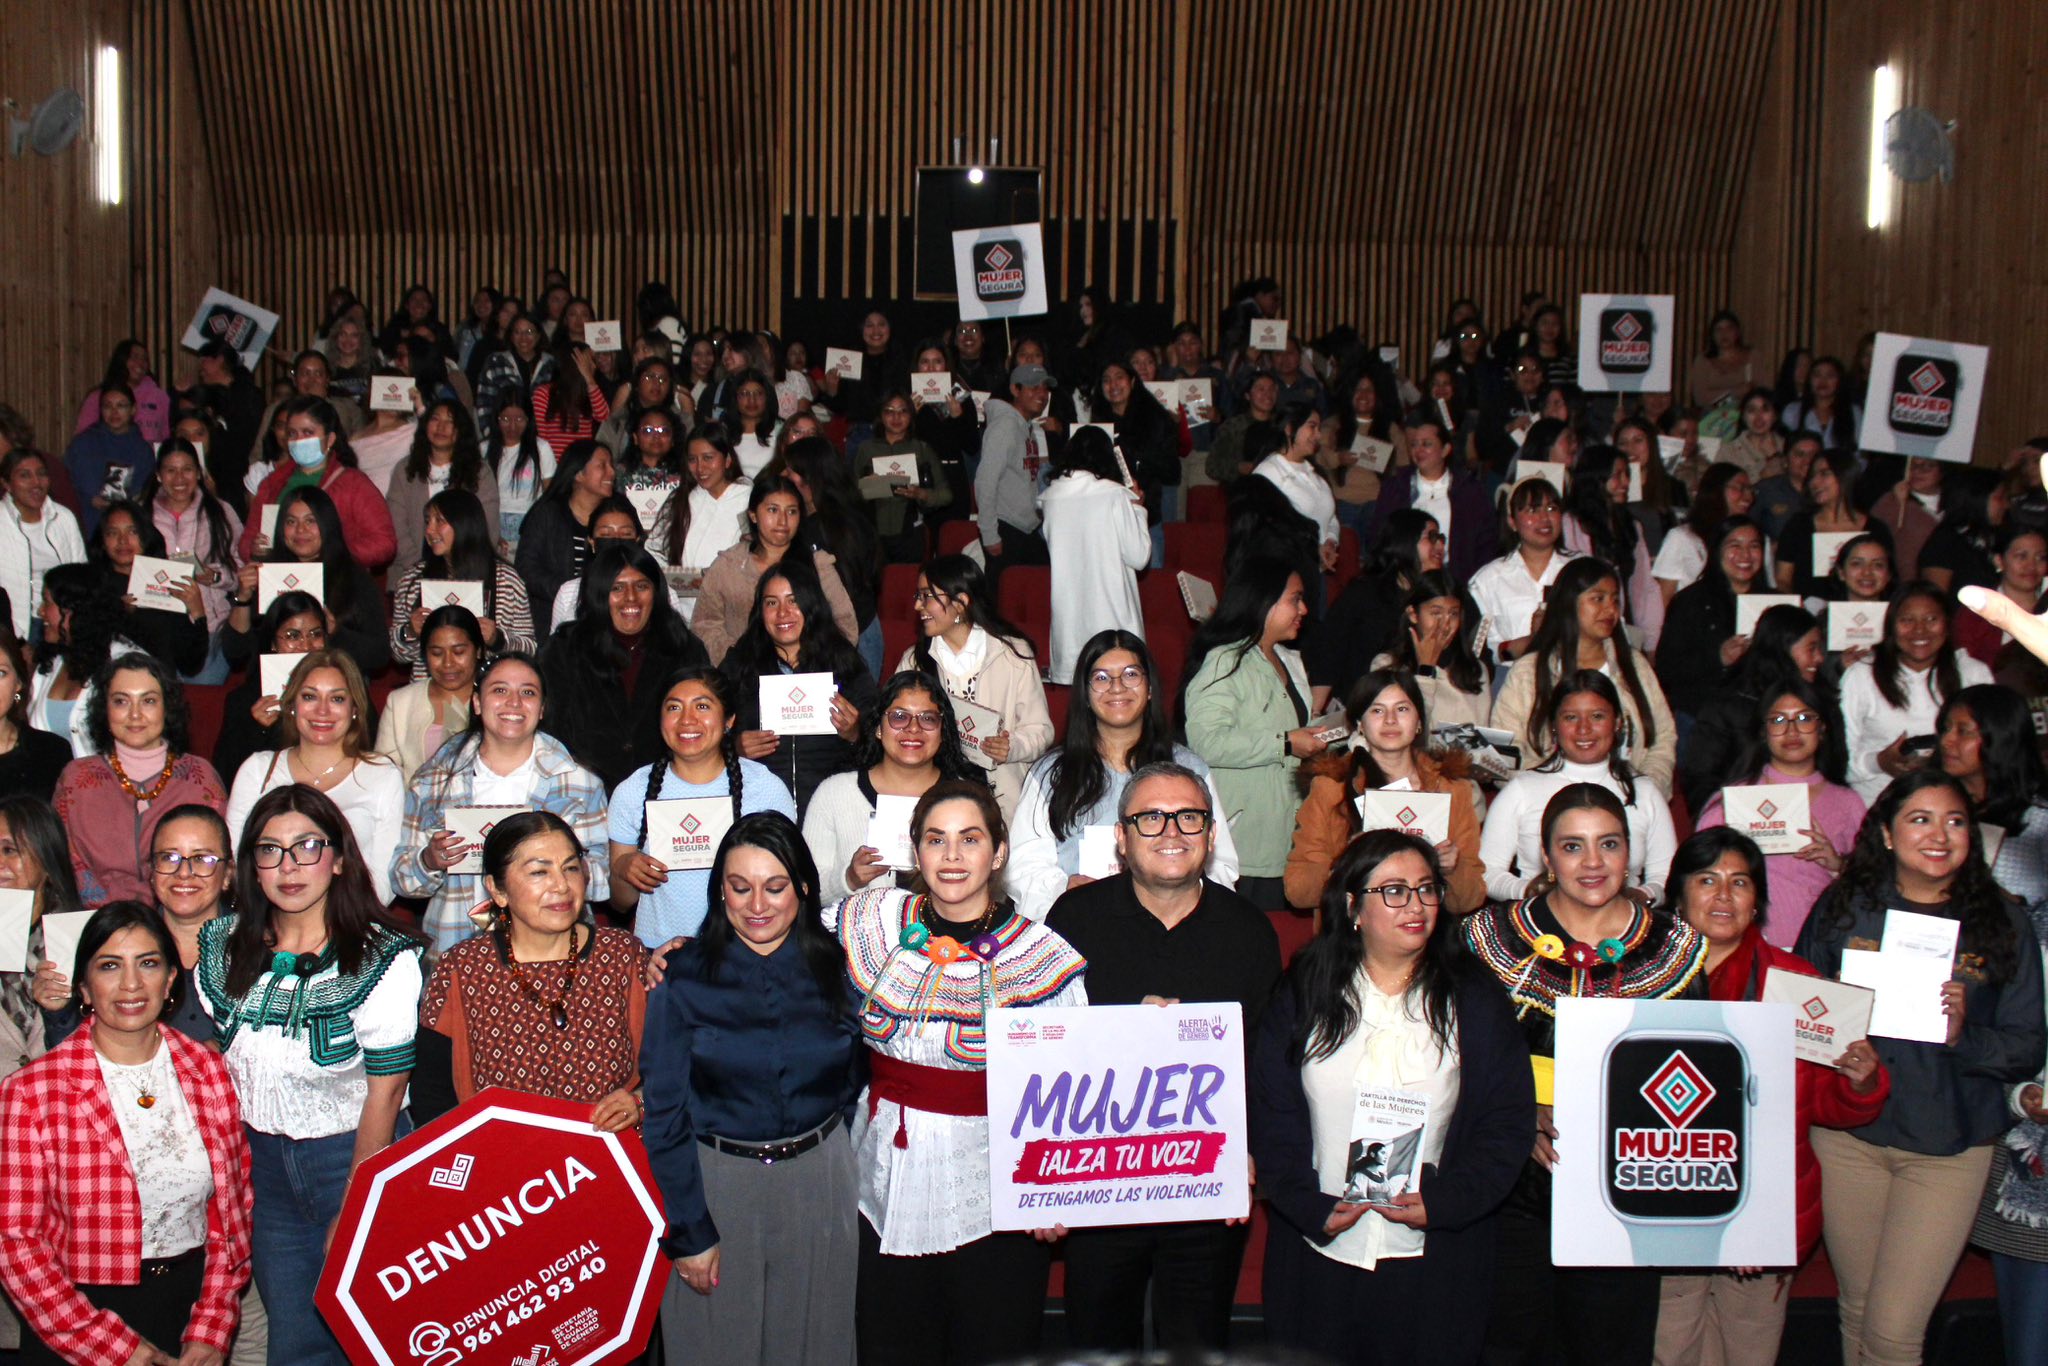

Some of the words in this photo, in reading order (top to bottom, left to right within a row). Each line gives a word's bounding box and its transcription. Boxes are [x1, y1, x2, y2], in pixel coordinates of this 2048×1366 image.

[978, 270, 1022, 283] MUJER
[980, 281, 1024, 292] SEGURA
[1603, 341, 1650, 353] MUJER
[1894, 394, 1951, 413] MUJER
[781, 705, 814, 713] MUJER
[960, 732, 979, 744] UJER
[1749, 821, 1786, 829] MUJER
[672, 835, 710, 845] MUJER
[673, 844, 711, 852] SEGURA
[1178, 1019, 1208, 1028] ALERTA
[1795, 1029, 1833, 1045] EGURA
[1010, 1063, 1225, 1139] MUJER
[1360, 1092, 1388, 1100] CARTILLA
[1396, 1097, 1427, 1107] DERECHOS
[1360, 1099, 1371, 1107] de
[1373, 1100, 1386, 1109] las
[1388, 1103, 1425, 1115] Mujeres
[1617, 1129, 1736, 1161] MUJER
[1038, 1146, 1106, 1177] ¡ALZA
[1114, 1143, 1144, 1171] TU
[1151, 1139, 1201, 1168] VOZ!
[1617, 1163, 1736, 1189] SEGURA
[1018, 1189, 1112, 1209] DETENGAMOS
[1115, 1187, 1142, 1203] LAS
[1146, 1182, 1224, 1201] VIOLENCIAS
[376, 1155, 597, 1301] DENUNCIA
[452, 1279, 538, 1336] DENUNCIA
[538, 1239, 600, 1283] DIGITAL
[463, 1320, 503, 1353] 961
[506, 1294, 547, 1328] 462
[546, 1276, 575, 1301] 93
[579, 1256, 606, 1282] 40
[551, 1306, 593, 1335] SECRETARÍA
[554, 1332, 565, 1340] DE
[575, 1309, 599, 1327] MUJER
[563, 1317, 598, 1342] IGUALDAD
[560, 1342, 571, 1350] DE
[571, 1323, 600, 1343] GÉNERO
